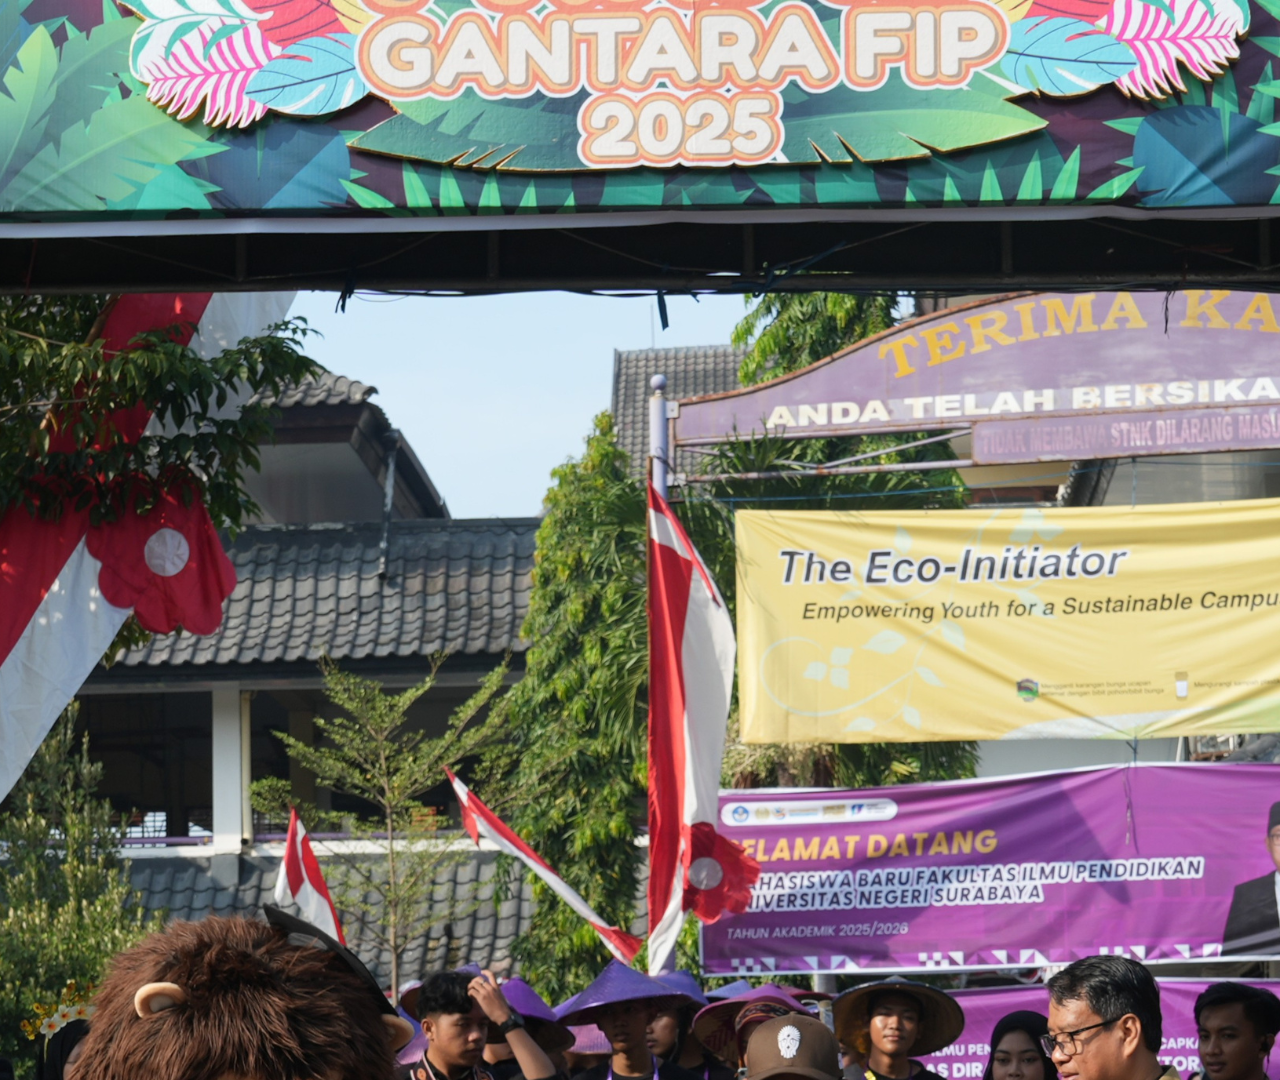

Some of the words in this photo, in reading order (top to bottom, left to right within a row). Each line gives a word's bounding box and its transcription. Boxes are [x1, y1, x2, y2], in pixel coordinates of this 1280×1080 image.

[367, 12, 833, 88] GANTARA
[854, 10, 998, 79] FIP
[588, 97, 775, 158] 2025
[878, 292, 1148, 379] TERIMA
[766, 399, 891, 429] ANDA
[904, 389, 1054, 419] TELAH
[980, 426, 1025, 454] TIDAK
[1029, 424, 1108, 452] MEMBAWA
[1110, 421, 1153, 448] STNK
[1155, 417, 1234, 445] DILARANG
[779, 550, 852, 583] The
[865, 543, 1127, 584] Eco-Initiator
[802, 602, 935, 623] Empowering
[942, 600, 1000, 618] Youth
[1007, 598, 1037, 617] for
[1043, 602, 1055, 616] a
[1062, 591, 1193, 615] Sustainable
[732, 835, 861, 863] ELAMAT
[867, 830, 998, 858] DATANG
[858, 870, 911, 888] BARU
[915, 865, 1017, 885] FAKULTAS
[1021, 864, 1071, 883] ILMU
[1075, 859, 1202, 880] PENDIDIKAN
[858, 887, 929, 906] NEGERI
[933, 884, 1042, 903] SURABAYA
[727, 927, 770, 940] TAHUN
[772, 925, 836, 938] AKADEMIK
[838, 920, 909, 938] 2025/2026
